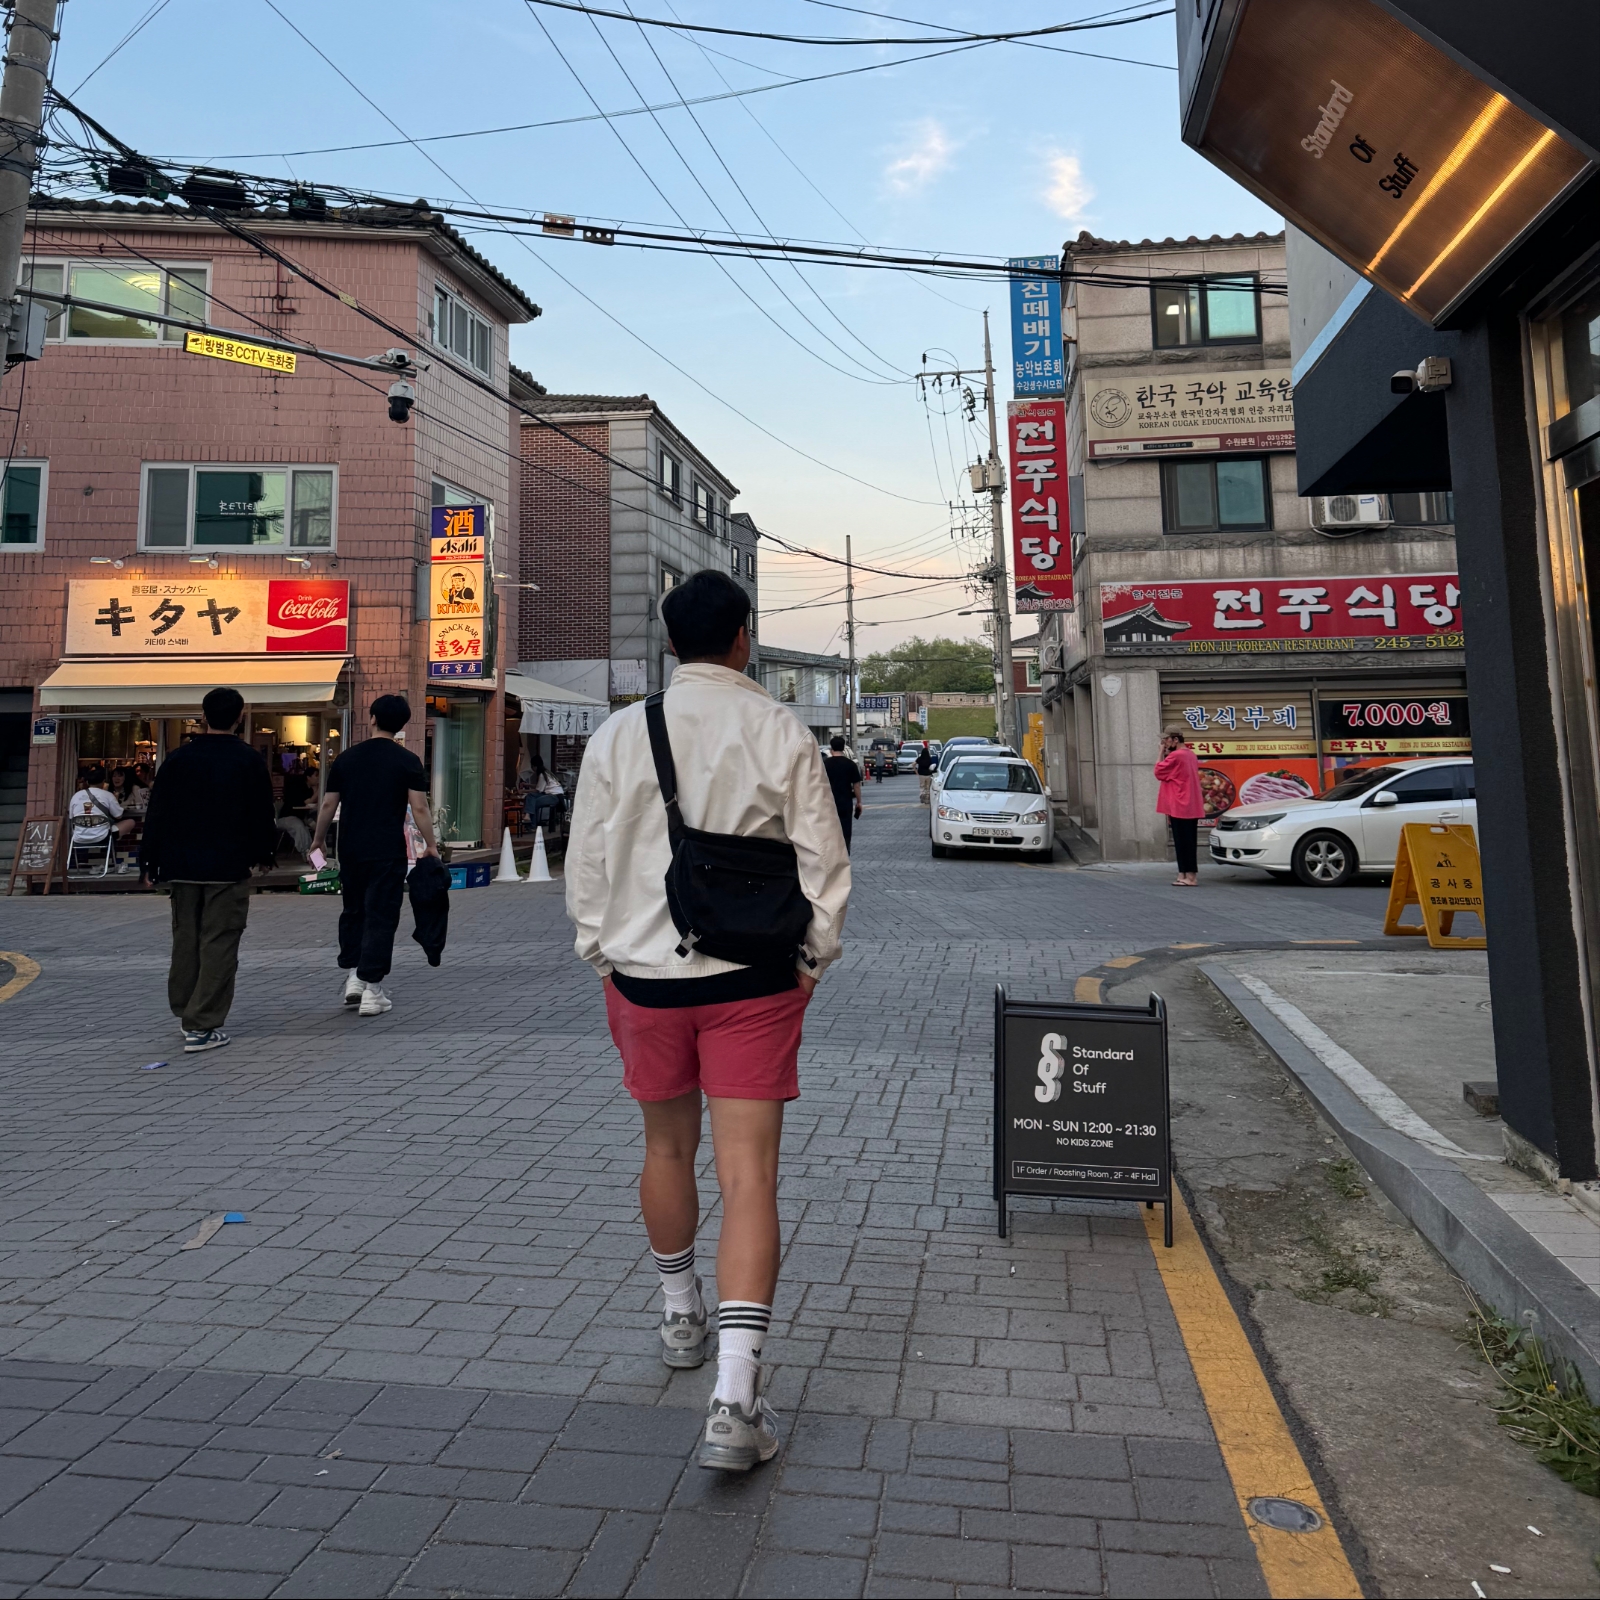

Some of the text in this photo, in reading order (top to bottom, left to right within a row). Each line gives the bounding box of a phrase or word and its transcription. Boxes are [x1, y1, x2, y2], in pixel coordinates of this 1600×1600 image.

[1300, 79, 1354, 159] Standard
[1349, 133, 1377, 164] Of
[1378, 152, 1419, 199] Stuff
[1015, 359, 1062, 379] 농악보존회
[1016, 379, 1063, 391] 수강생수시모집
[1136, 384, 1177, 409] 한국
[1185, 380, 1227, 406] 국악
[1137, 409, 1177, 420] 교육부소관
[1249, 406, 1265, 415] 인증
[1138, 421, 1170, 429] KOREAN
[1172, 419, 1199, 427] GUGAK
[1202, 417, 1256, 426] EDUCATIONAL
[1016, 420, 1062, 571] 전주식당
[443, 508, 475, 537] 酒
[440, 538, 477, 553] Asahi
[1132, 589, 1183, 600] 한식전문
[437, 602, 480, 614] KITAYA
[1212, 583, 1461, 631] 전주식당
[94, 597, 242, 637] キタヤ
[438, 623, 479, 640] SNACK BAR
[434, 639, 481, 657] 喜多屋
[1188, 640, 1215, 653] JEON
[1219, 640, 1233, 652] JU
[1236, 639, 1280, 651] KOREAN
[1284, 638, 1356, 651] RESTAURANT
[1342, 702, 1452, 726] 7.000원
[40, 726, 51, 734] 15
[1072, 1046, 1134, 1061] Standard
[1072, 1063, 1090, 1076] Of
[1073, 1080, 1107, 1094] Stuff
[1013, 1117, 1043, 1131] MON
[1052, 1119, 1079, 1133] SUN
[1082, 1121, 1113, 1135] 12:00
[1125, 1124, 1157, 1137] 21:30
[1056, 1137, 1114, 1149] NO KIDS ZONE
[1016, 1165, 1025, 1174] 1F
[1026, 1166, 1047, 1175] Order
[1053, 1168, 1086, 1179] Roasting
[1113, 1171, 1123, 1179] 2F
[1130, 1172, 1140, 1180] 4F
[1141, 1173, 1156, 1181] Hall
